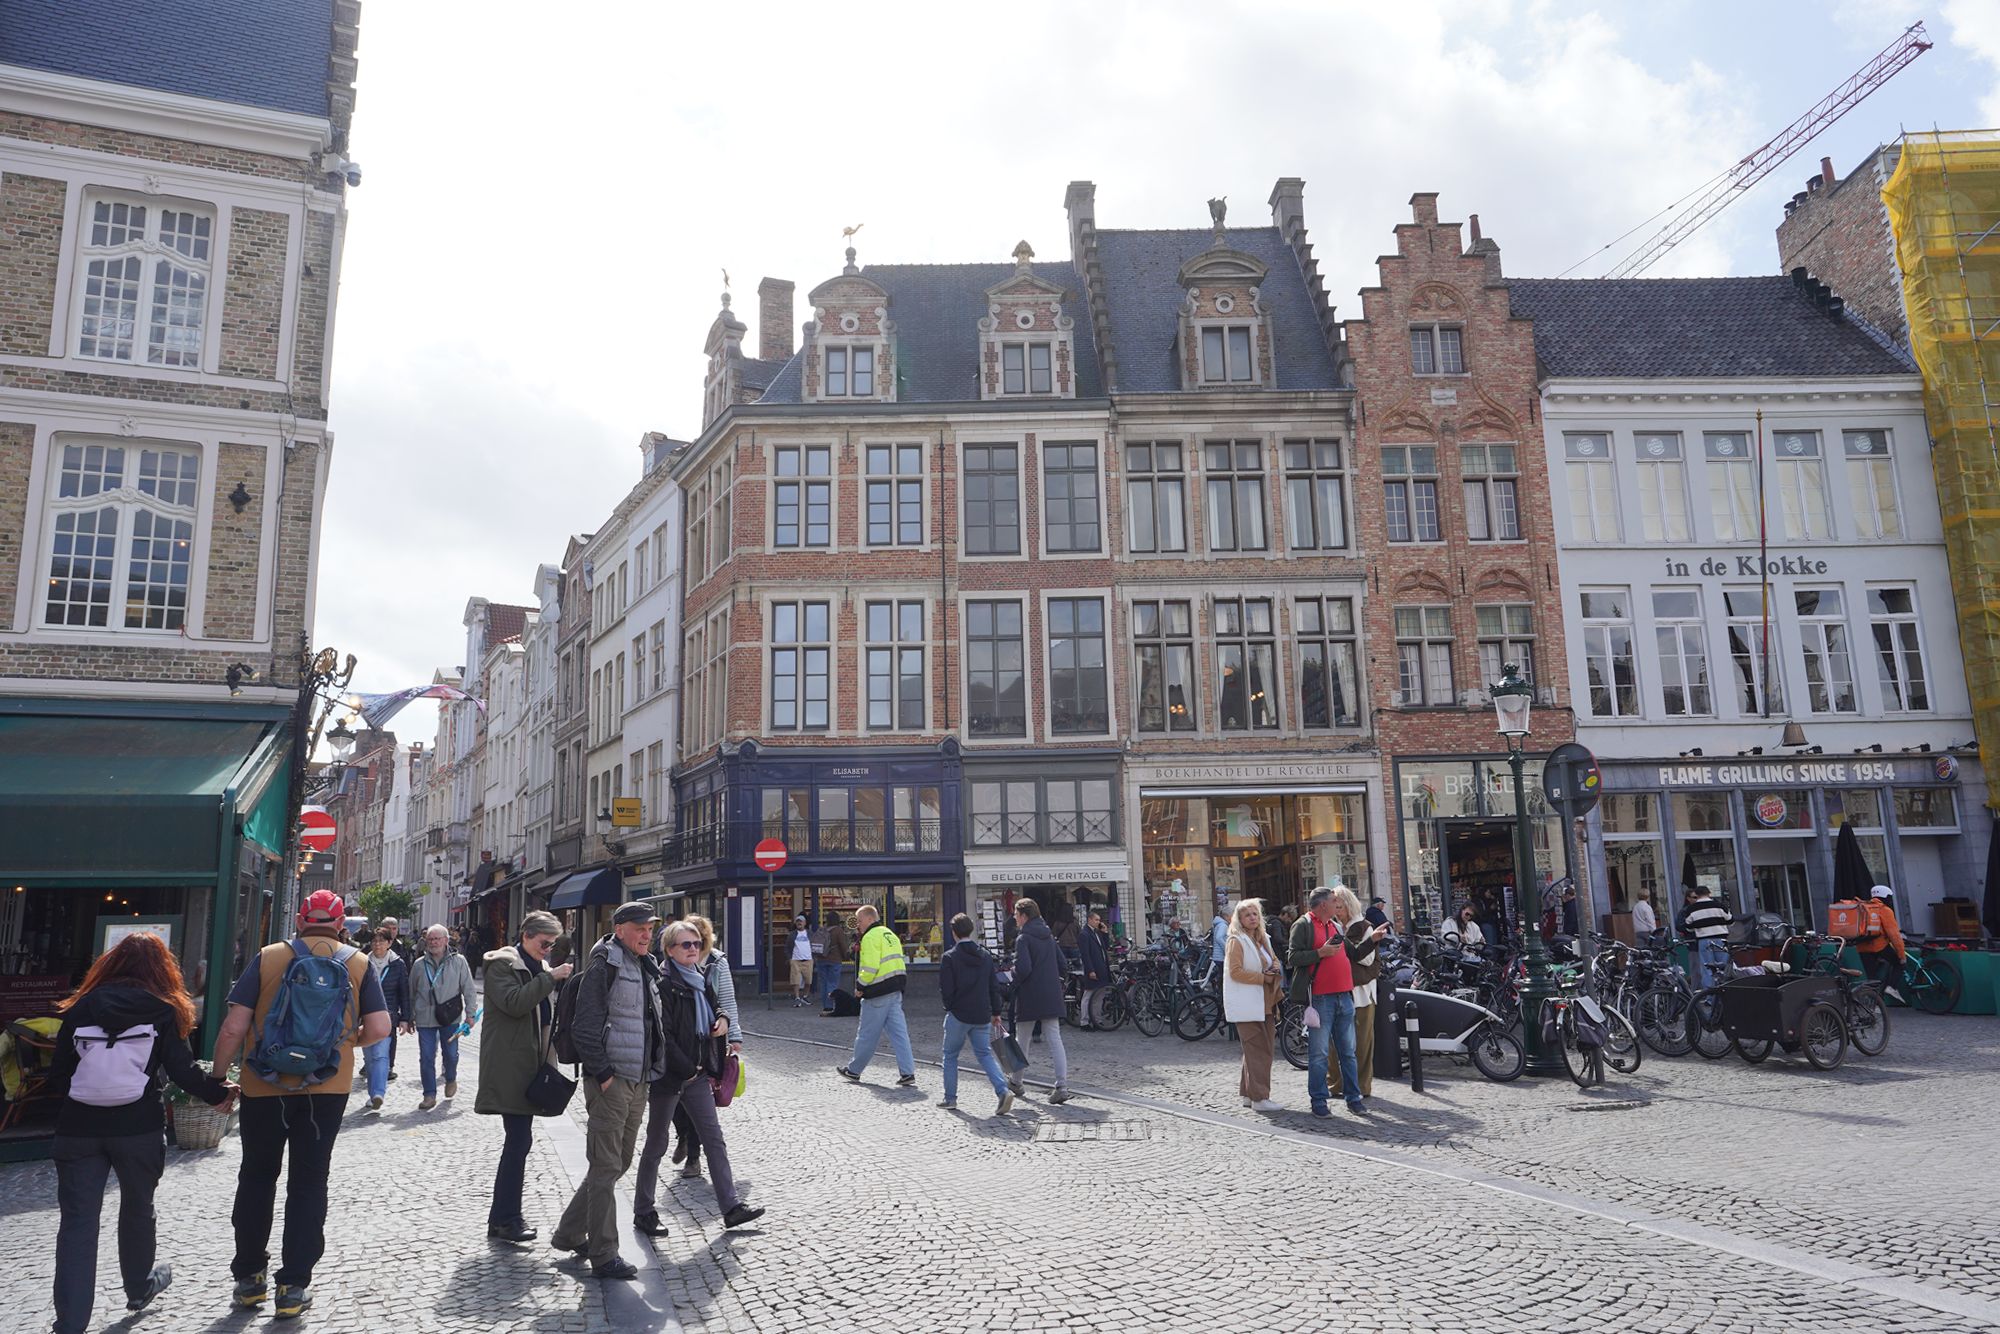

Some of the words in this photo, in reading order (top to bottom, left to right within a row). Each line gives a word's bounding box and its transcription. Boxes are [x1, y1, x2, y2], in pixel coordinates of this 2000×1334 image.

[1666, 557, 1690, 576] in
[1700, 557, 1727, 576] de
[833, 767, 869, 775] ELISABETH
[1155, 768, 1250, 778] BOEKHANDEL
[1256, 767, 1273, 777] DE
[1279, 765, 1351, 776] REYGHERE
[1658, 767, 1713, 784] FLAME
[1718, 764, 1795, 784] GRILLING
[1800, 764, 1846, 782] SINCE
[1852, 763, 1896, 781] 1954
[1760, 806, 1784, 818] KING
[991, 873, 1043, 881] BELGIAN
[1049, 871, 1107, 880] HERITAGE
